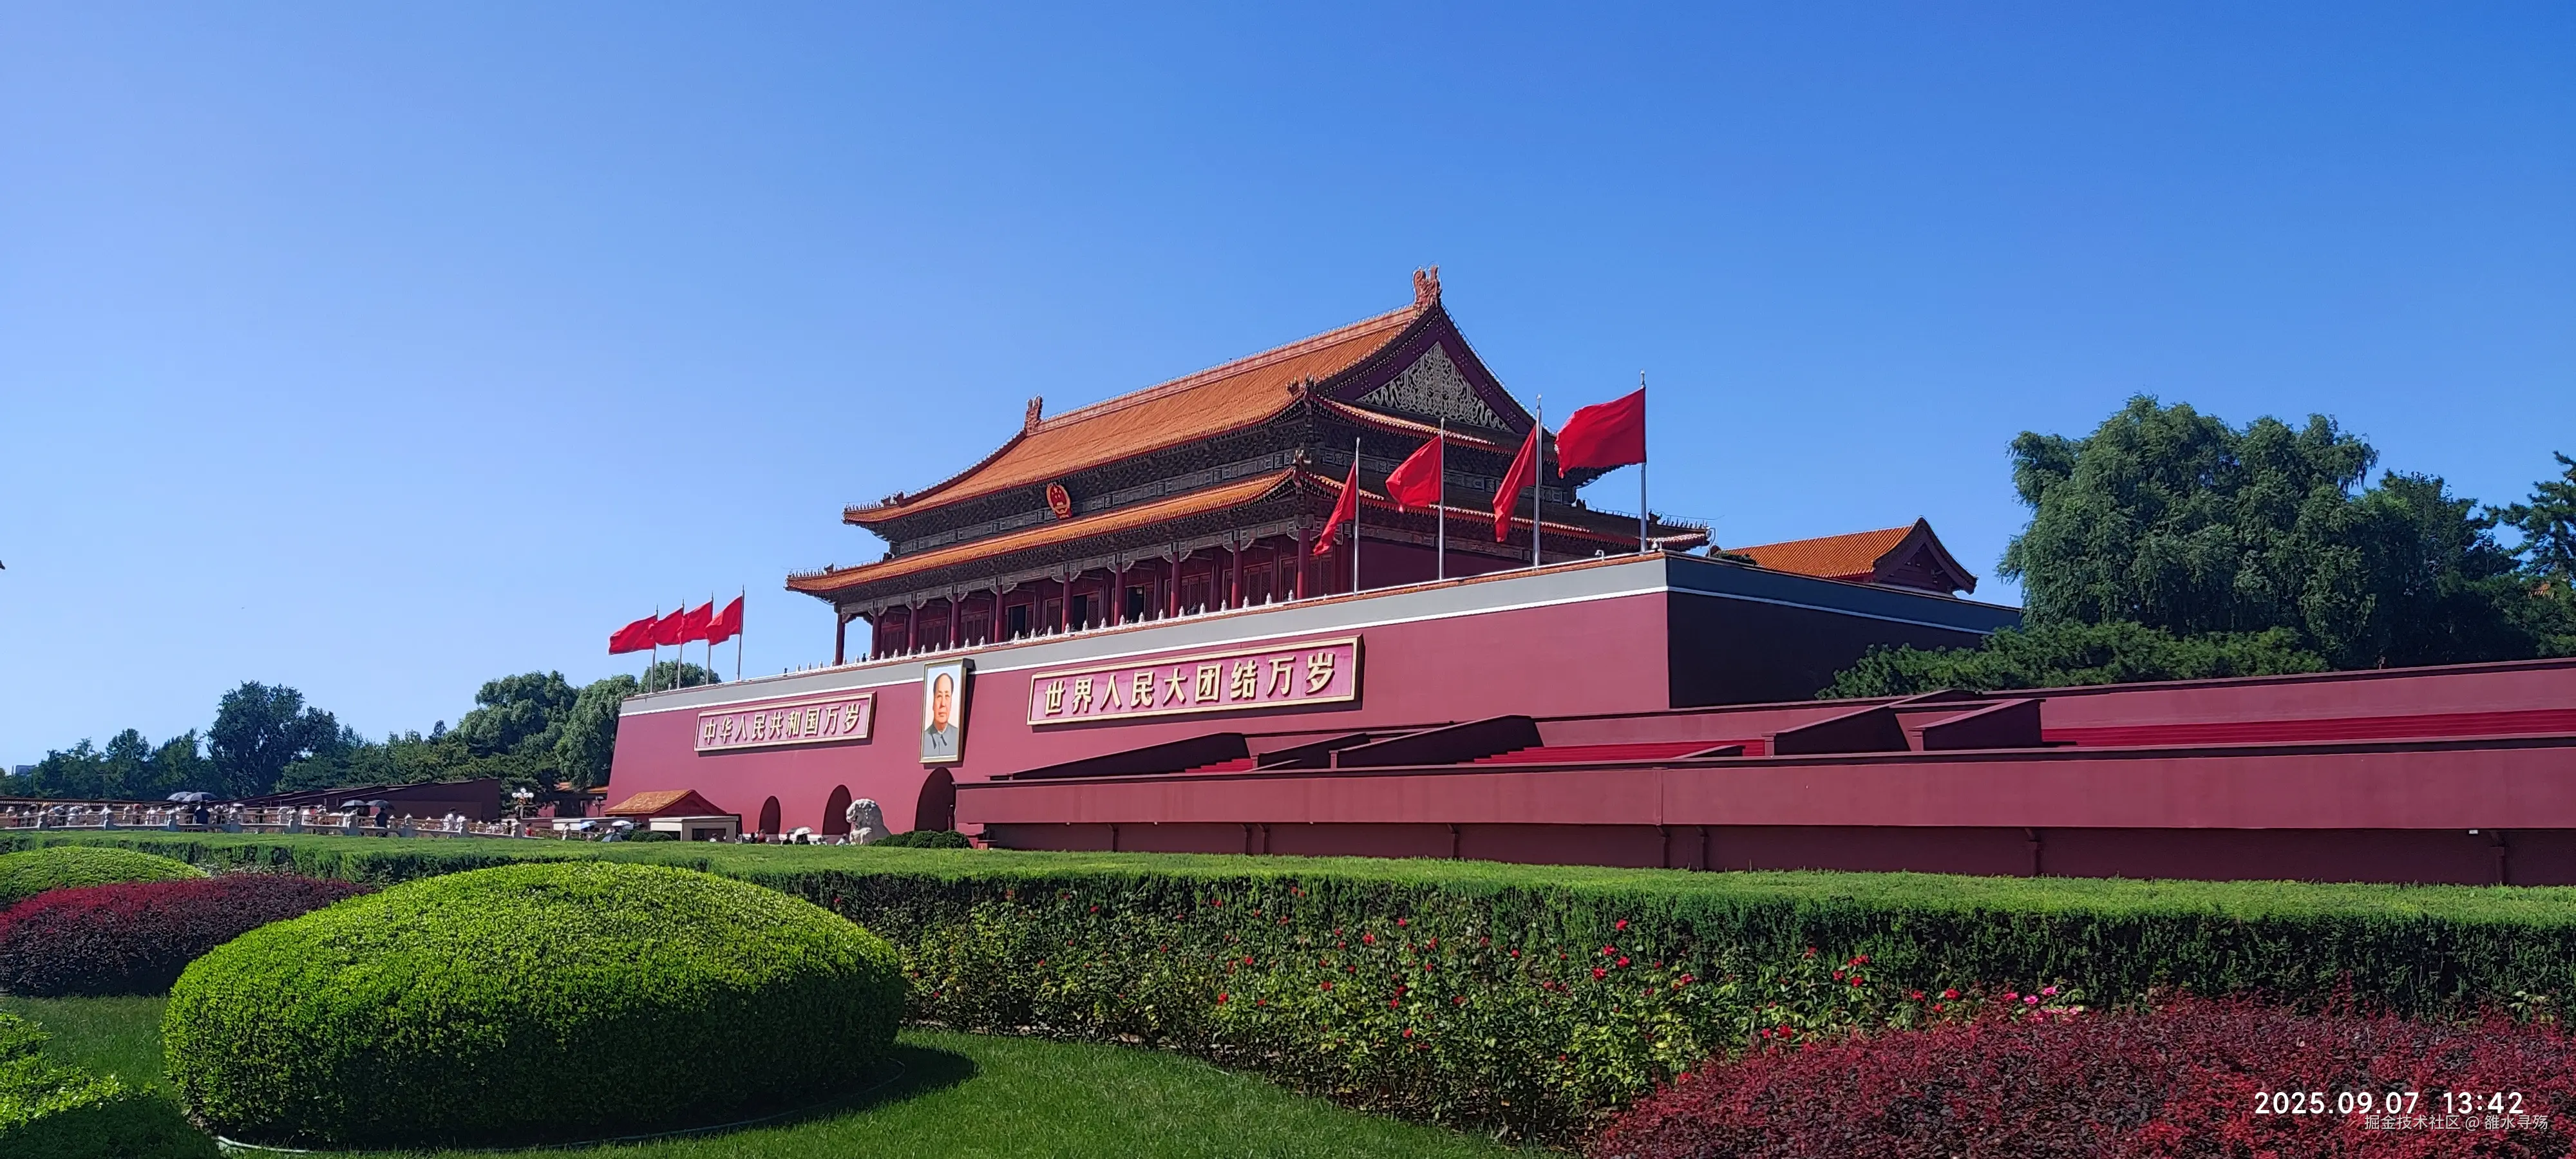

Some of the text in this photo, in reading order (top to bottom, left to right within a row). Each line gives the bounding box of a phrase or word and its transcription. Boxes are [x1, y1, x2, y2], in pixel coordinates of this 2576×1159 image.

[1044, 652, 1336, 715] 世界人民大团结万岁
[703, 703, 861, 744] 中华人民共和国万岁
